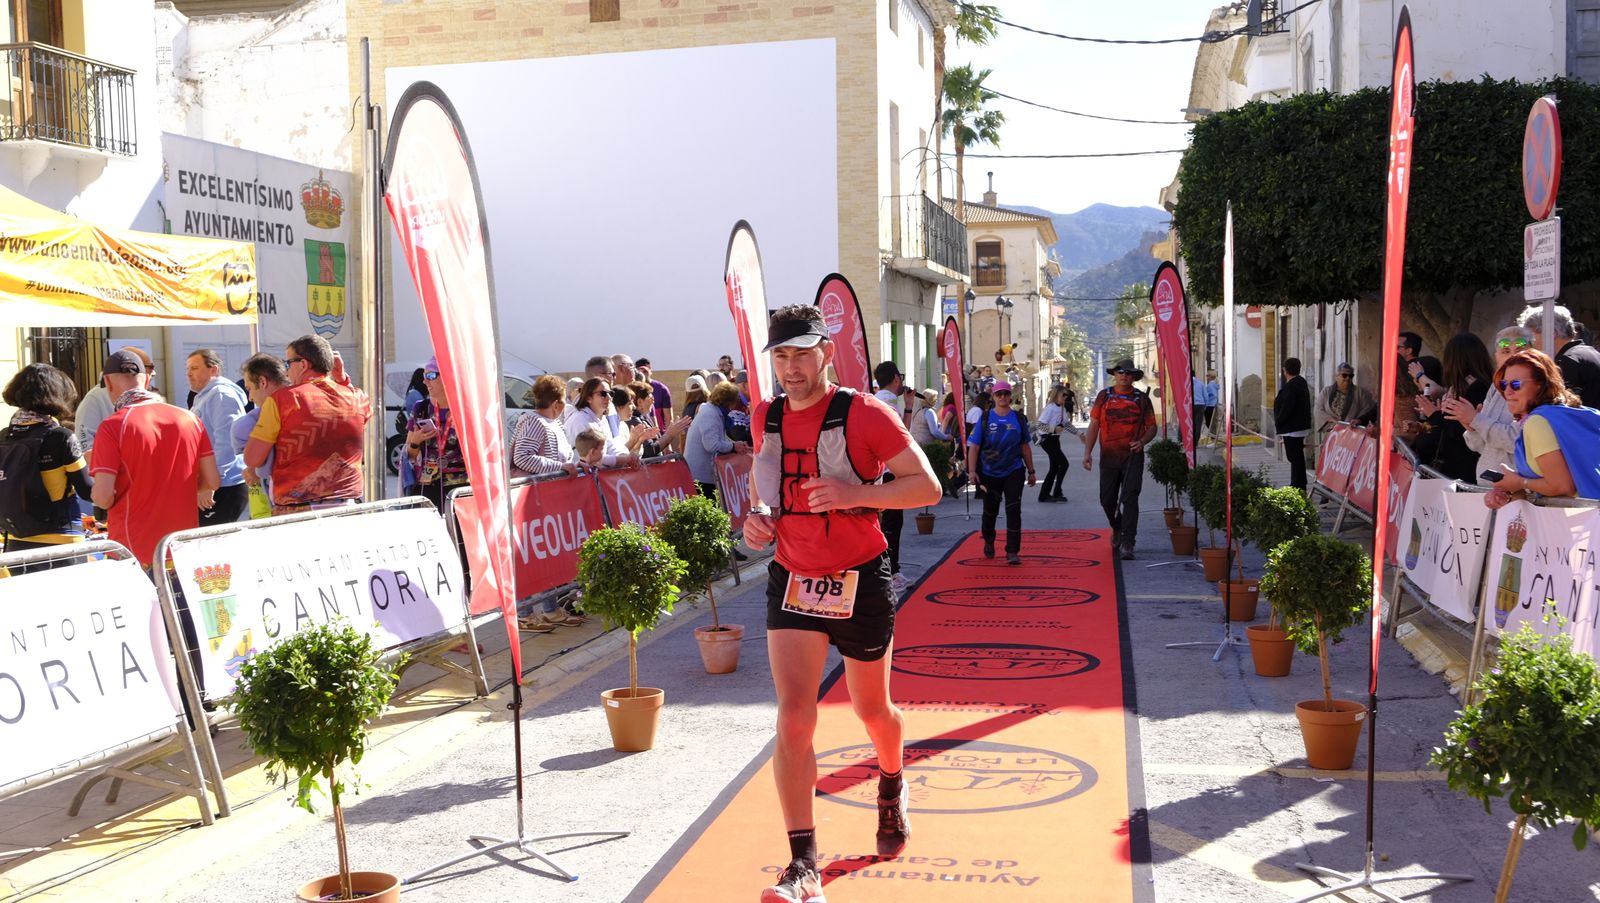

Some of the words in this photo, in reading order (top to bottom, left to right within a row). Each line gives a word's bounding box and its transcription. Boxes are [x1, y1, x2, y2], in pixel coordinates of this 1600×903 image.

[177, 169, 294, 212] EXCELENTÍSIMO
[184, 209, 295, 247] AYUNTAMIENTO
[512, 508, 589, 565] VEOLIA
[1460, 527, 1481, 545] DE
[256, 543, 409, 588] AYUNTAMENTO
[416, 538, 439, 557] DE
[801, 578, 844, 597] 108
[261, 562, 452, 639] CANTORIA
[10, 617, 76, 655] NTO
[90, 605, 126, 635] DE
[899, 707, 1062, 716] Ayuntamien
[1016, 755, 1059, 765] LA
[816, 853, 958, 867] Cantori
[971, 858, 1019, 870] de
[760, 865, 1041, 887] Ayuntamieo
